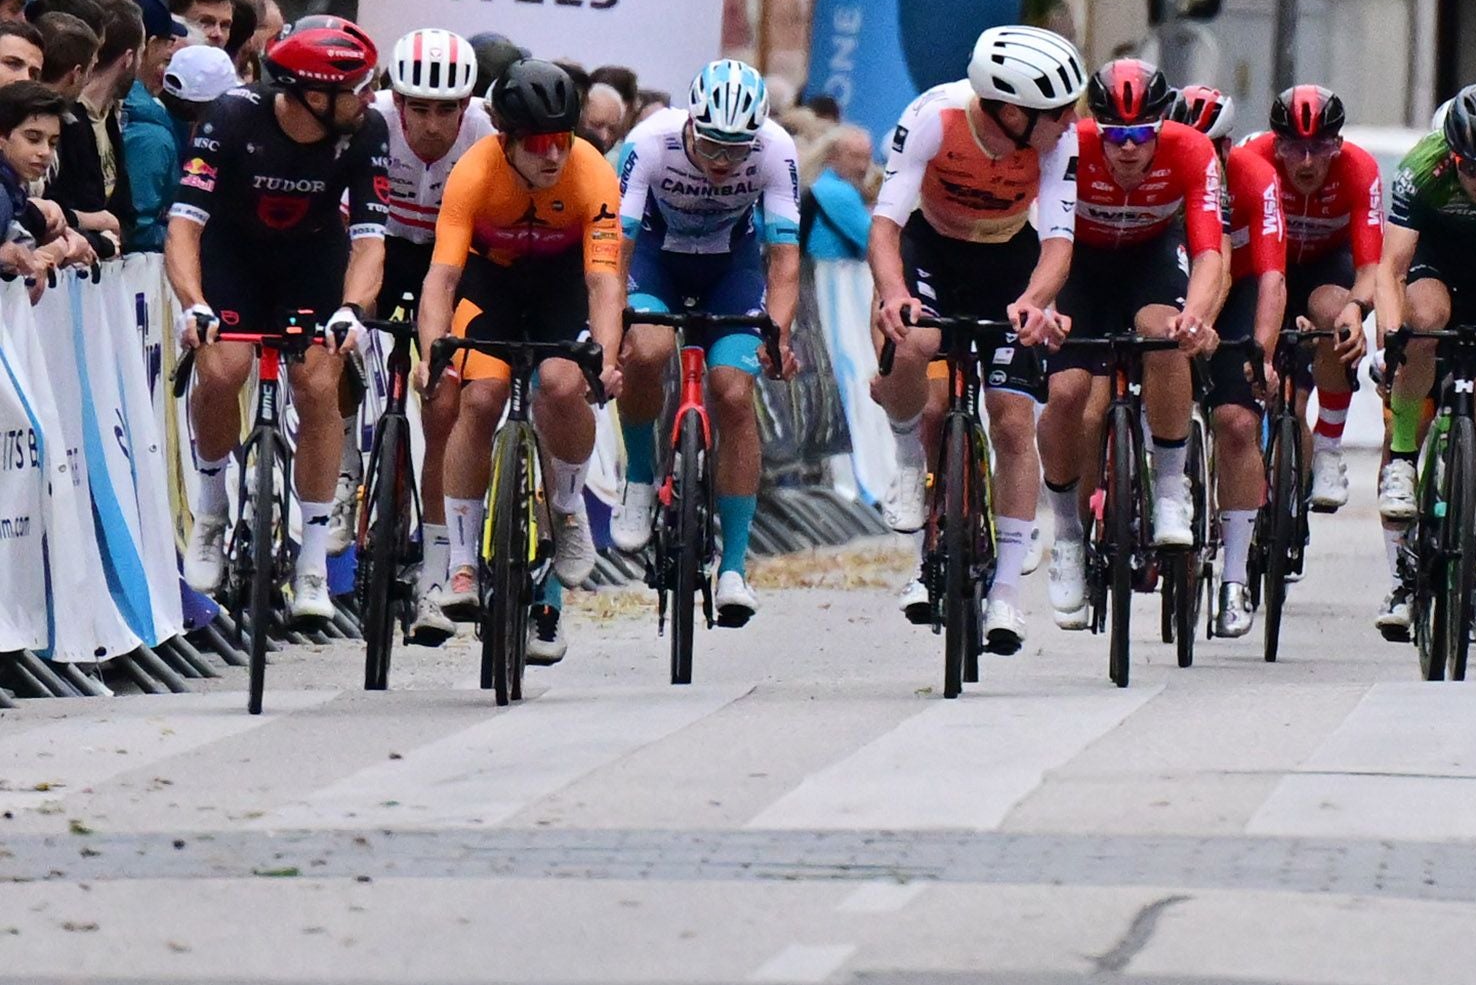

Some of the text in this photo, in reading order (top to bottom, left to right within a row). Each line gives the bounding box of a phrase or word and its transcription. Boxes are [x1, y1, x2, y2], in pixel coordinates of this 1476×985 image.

[298, 69, 346, 81] OAKLEY
[252, 174, 327, 193] TUDOR
[660, 177, 760, 197] CANNIBAL
[1202, 156, 1221, 212] WSA
[1263, 182, 1280, 236] WSA
[1367, 176, 1382, 227] WSA
